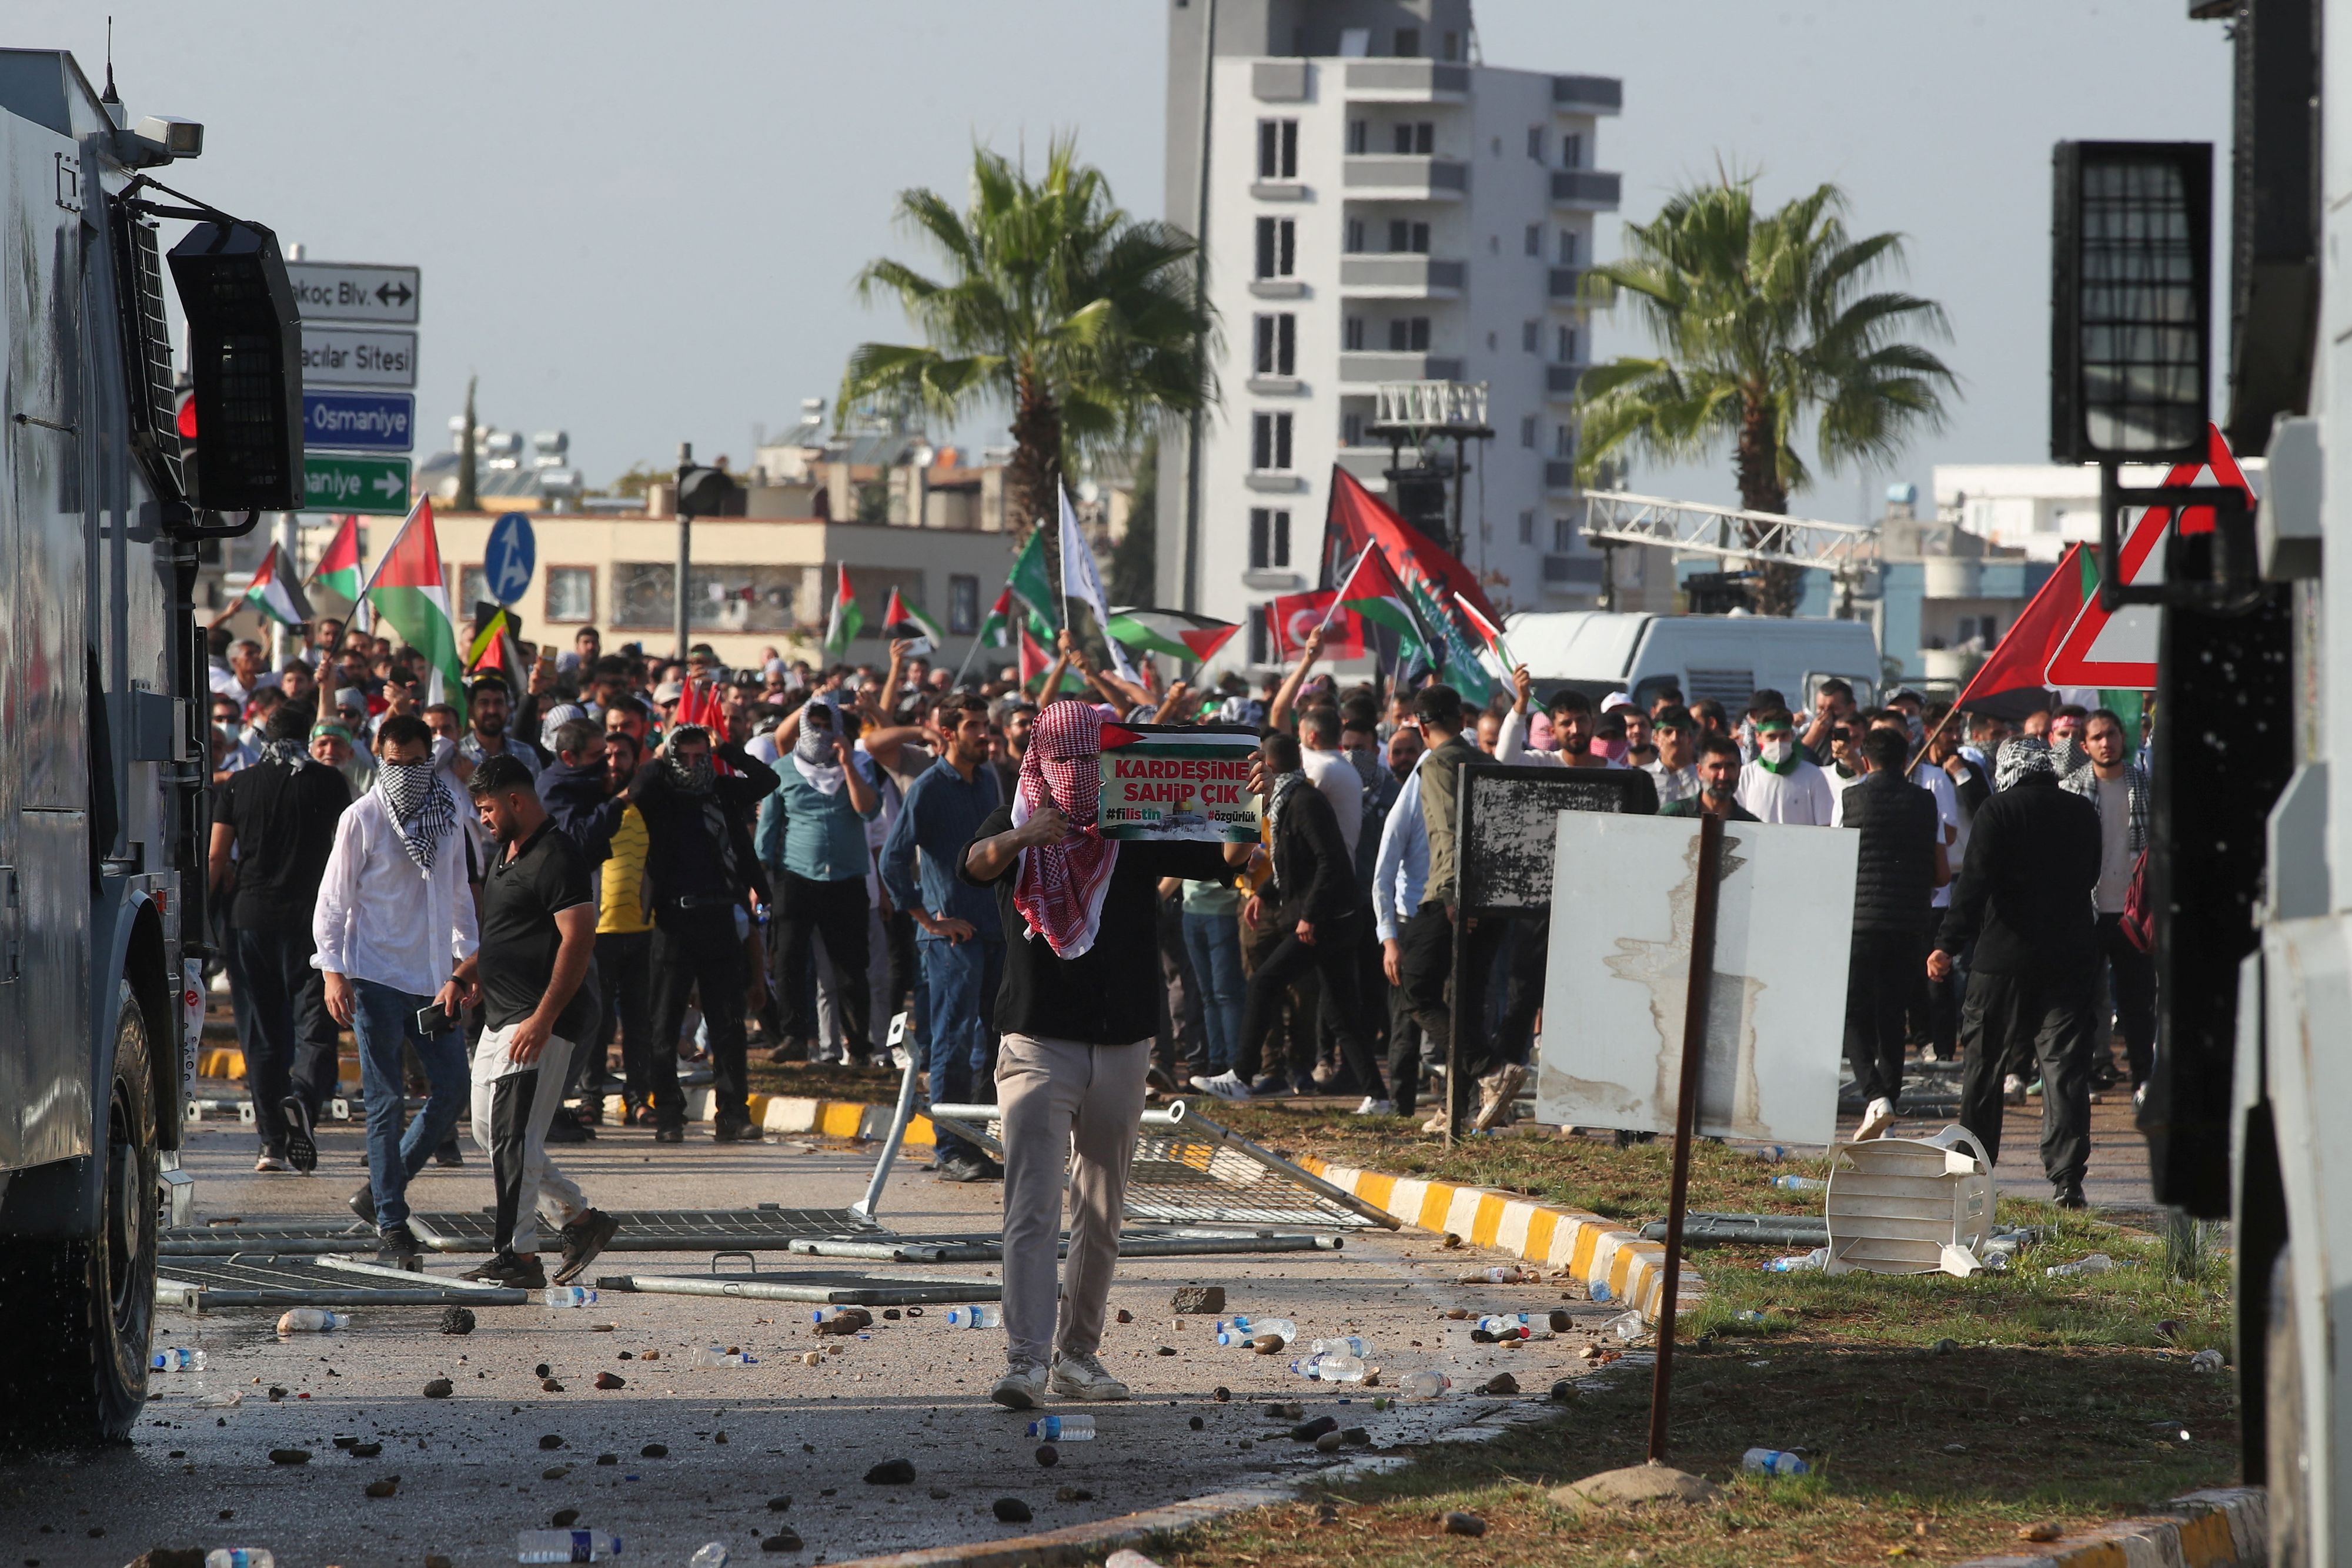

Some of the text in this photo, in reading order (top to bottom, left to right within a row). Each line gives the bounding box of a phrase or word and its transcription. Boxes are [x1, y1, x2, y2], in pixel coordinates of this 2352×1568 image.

[339, 282, 372, 306] Blv.
[356, 346, 410, 370] Sitesi
[313, 403, 407, 437] Osmaniye
[1201, 785, 1240, 806] ÇIK
[1106, 808, 1256, 823] #filistin #özgürlük
